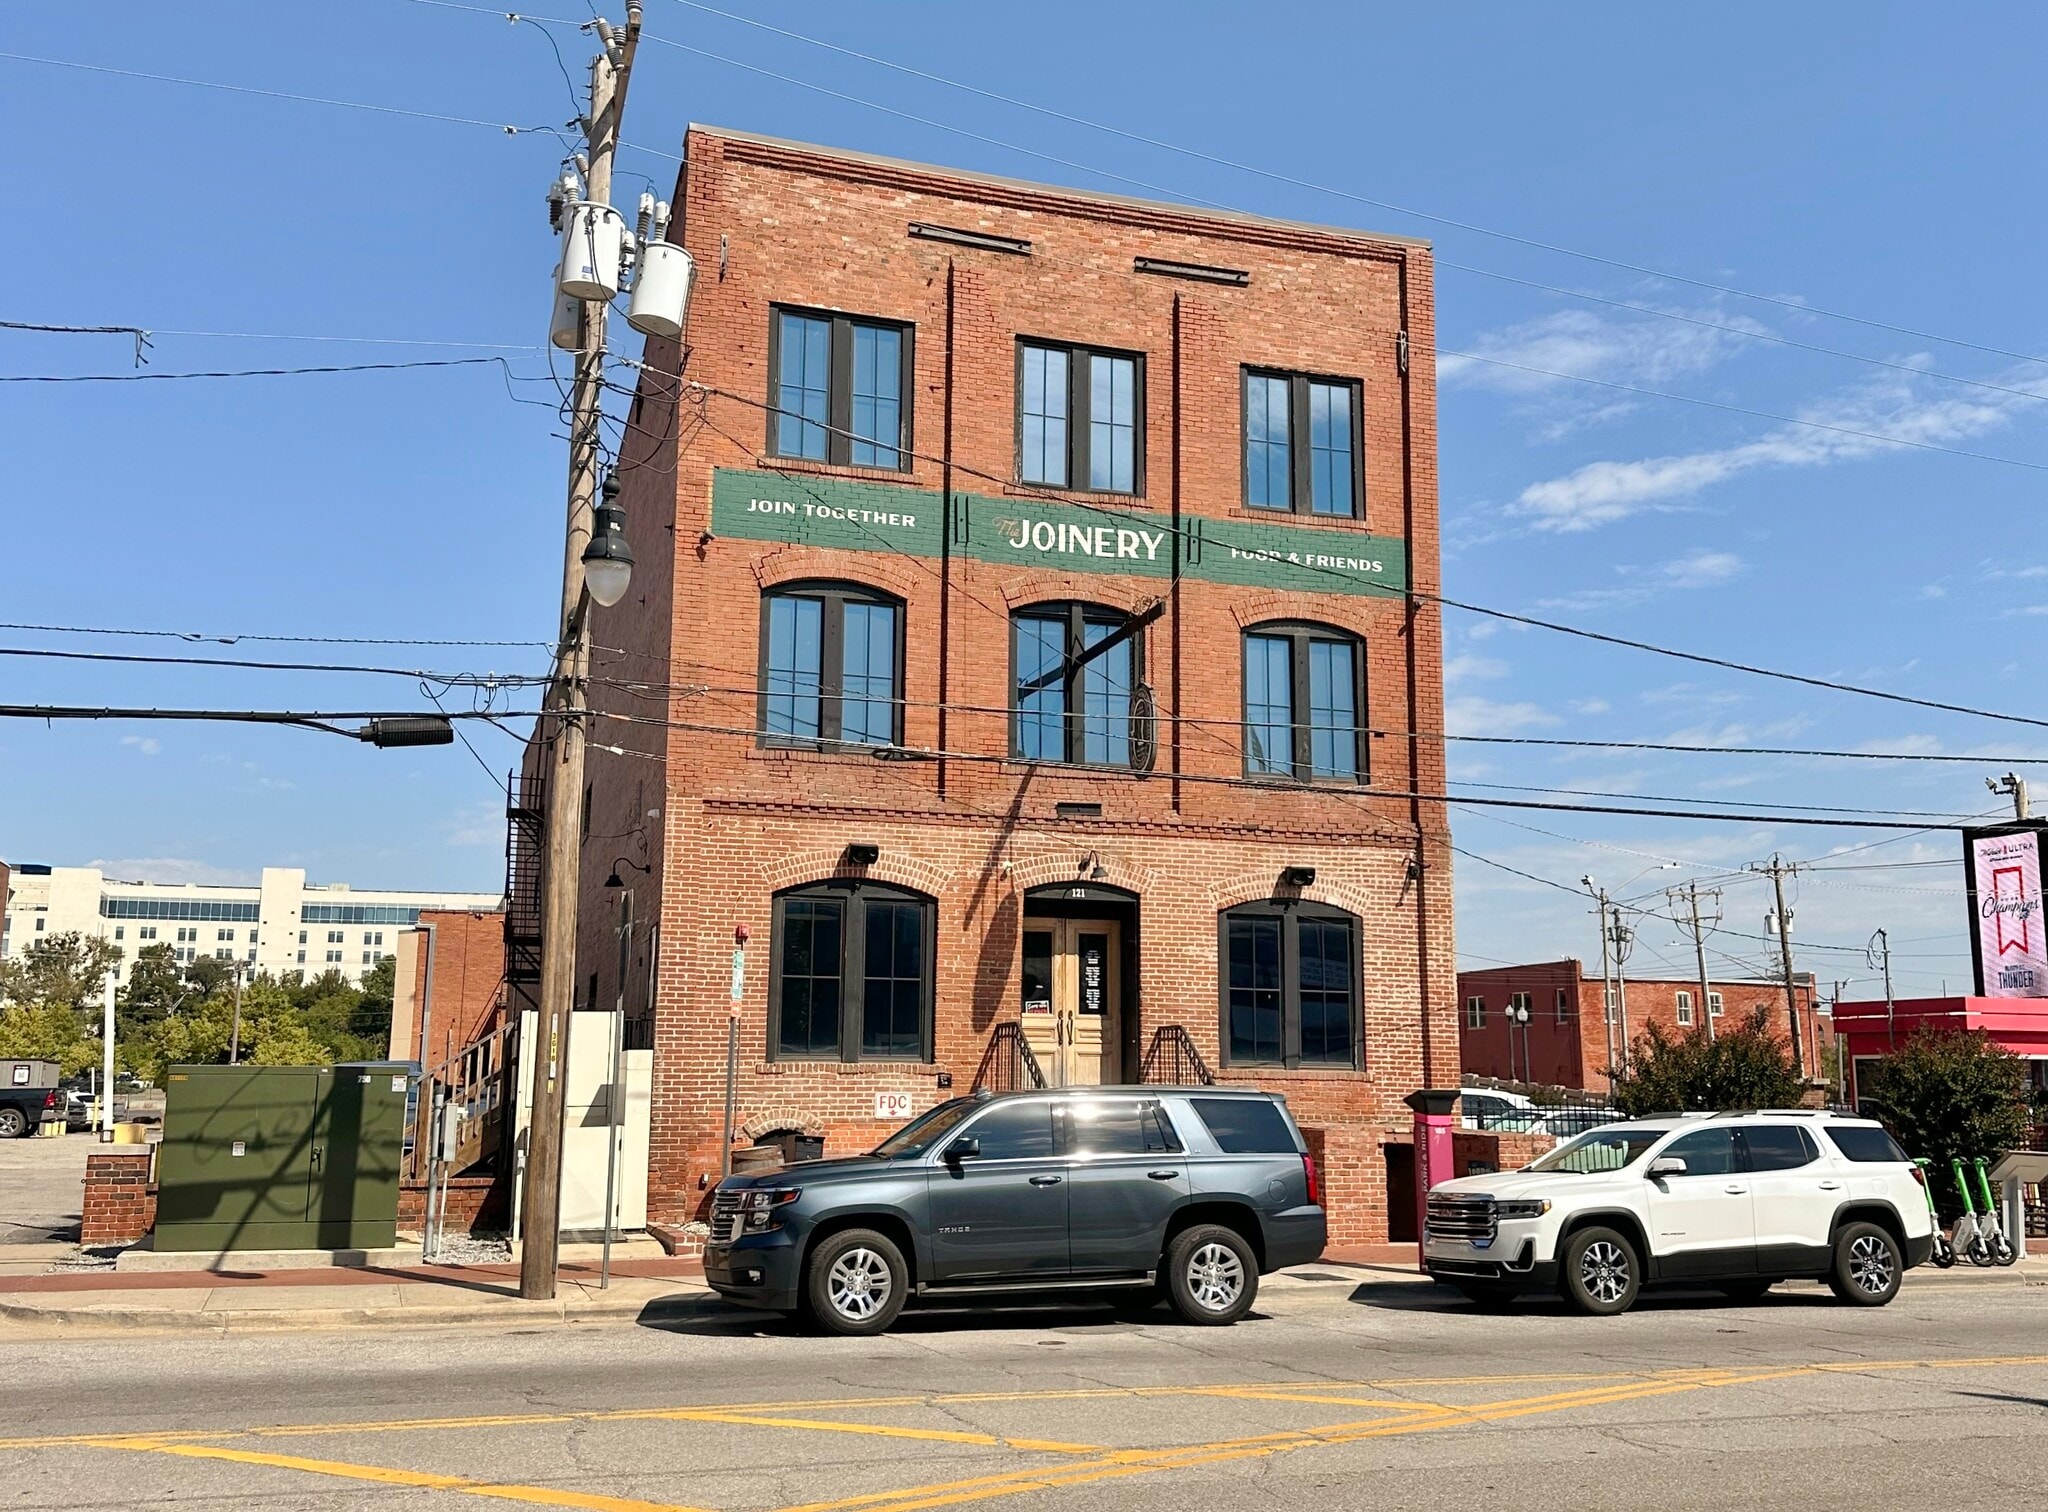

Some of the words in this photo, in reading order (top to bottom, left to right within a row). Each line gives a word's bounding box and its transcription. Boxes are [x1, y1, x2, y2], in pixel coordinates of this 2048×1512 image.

[747, 499, 796, 514] JOIN
[803, 503, 916, 527] TOGETHER
[992, 516, 1020, 538] The
[1009, 519, 1165, 560] JOINERY
[1286, 552, 1300, 564] &
[1305, 554, 1383, 572] FRIENDS
[2008, 843, 2034, 852] ULTRA
[1072, 888, 1085, 897] 121
[1998, 971, 2034, 989] THUNDER
[880, 1096, 907, 1109] FDC
